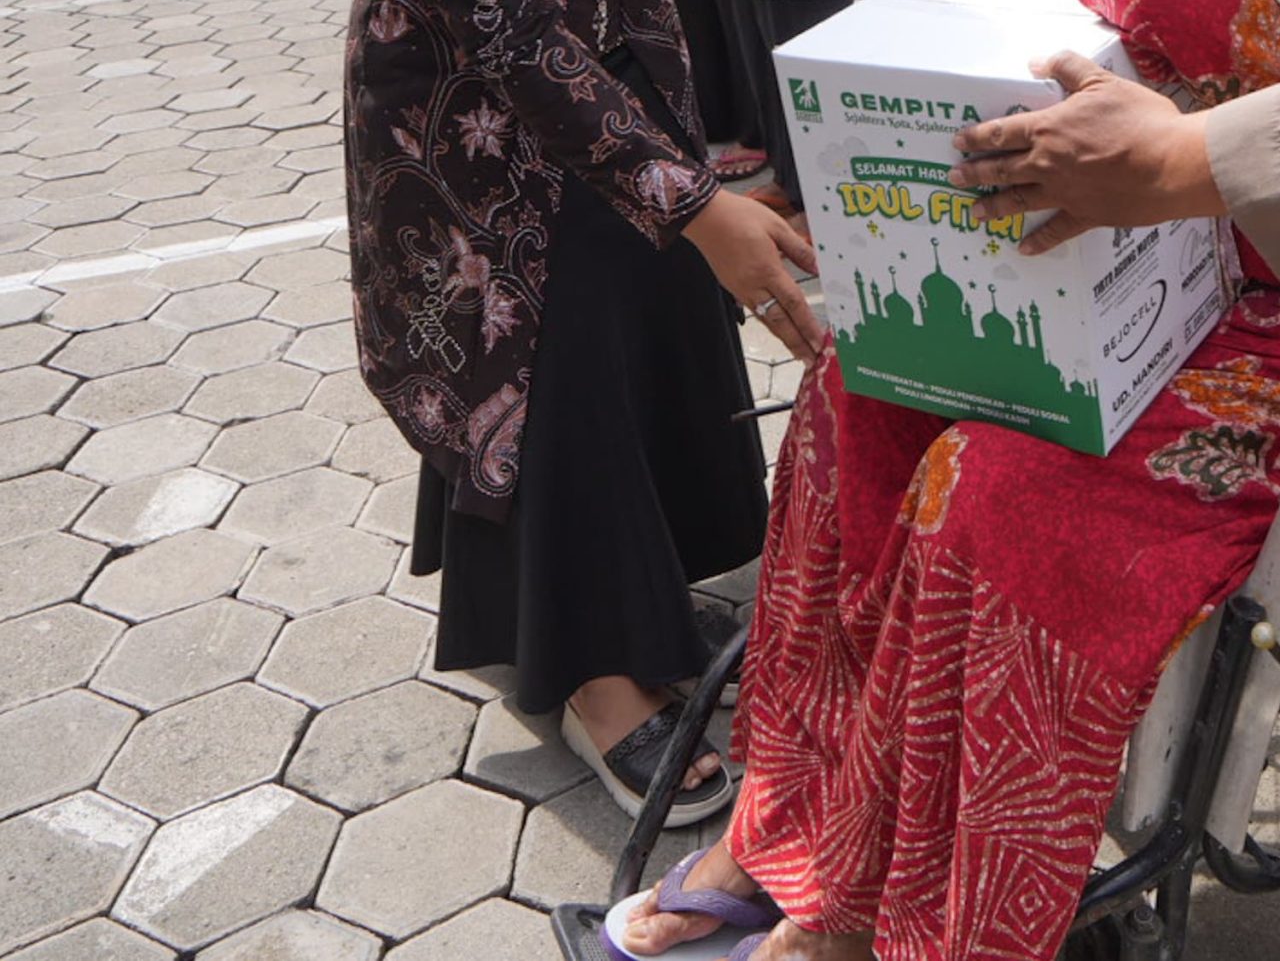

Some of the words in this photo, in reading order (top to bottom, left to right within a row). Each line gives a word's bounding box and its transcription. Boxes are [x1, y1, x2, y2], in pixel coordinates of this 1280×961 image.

[840, 91, 982, 123] GEMPITA
[844, 111, 886, 127] Sejahtera
[886, 116, 914, 131] Kota,
[914, 120, 958, 135] Sejahtera
[855, 163, 915, 177] SELAMAT
[918, 166, 948, 182] HAR
[838, 183, 923, 221] IDUL
[1102, 296, 1158, 358] BEJOCELL
[1112, 390, 1131, 413] UD.
[1132, 337, 1174, 391] MANDIRI
